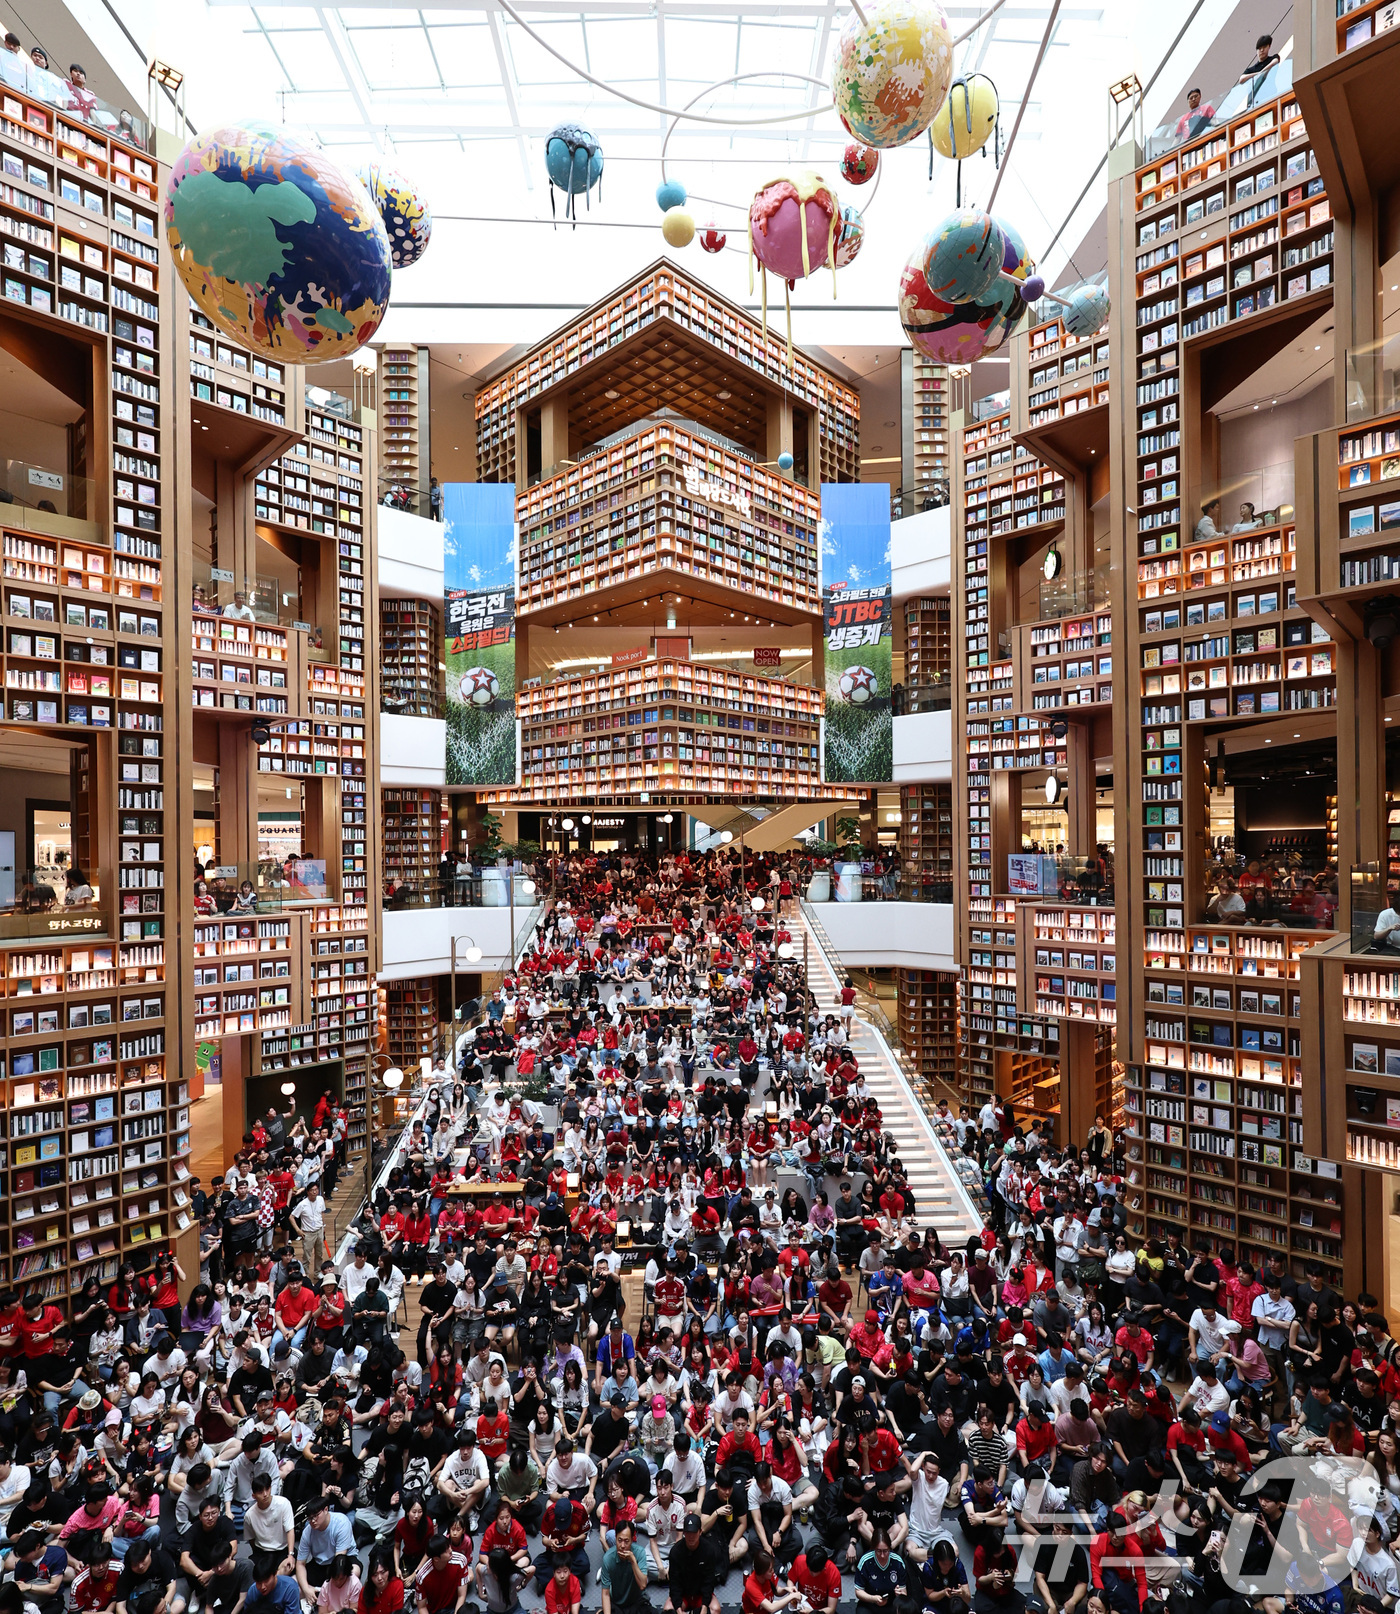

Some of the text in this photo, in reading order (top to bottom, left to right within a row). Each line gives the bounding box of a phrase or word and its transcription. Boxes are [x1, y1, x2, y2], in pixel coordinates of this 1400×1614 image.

[829, 588, 868, 604] 스타필드
[449, 592, 508, 623] 한국전
[828, 599, 884, 627] JTBC
[460, 615, 494, 634] 응원은
[450, 626, 511, 654] 스타필드!
[827, 622, 884, 651] 생중계
[615, 650, 643, 662] Nook port
[755, 657, 779, 666] OPEN
[1086, 1336, 1104, 1348] AIA
[1352, 1405, 1371, 1425] AIA
[454, 1468, 477, 1478] SEOUL
[1358, 1570, 1381, 1596] AIA
